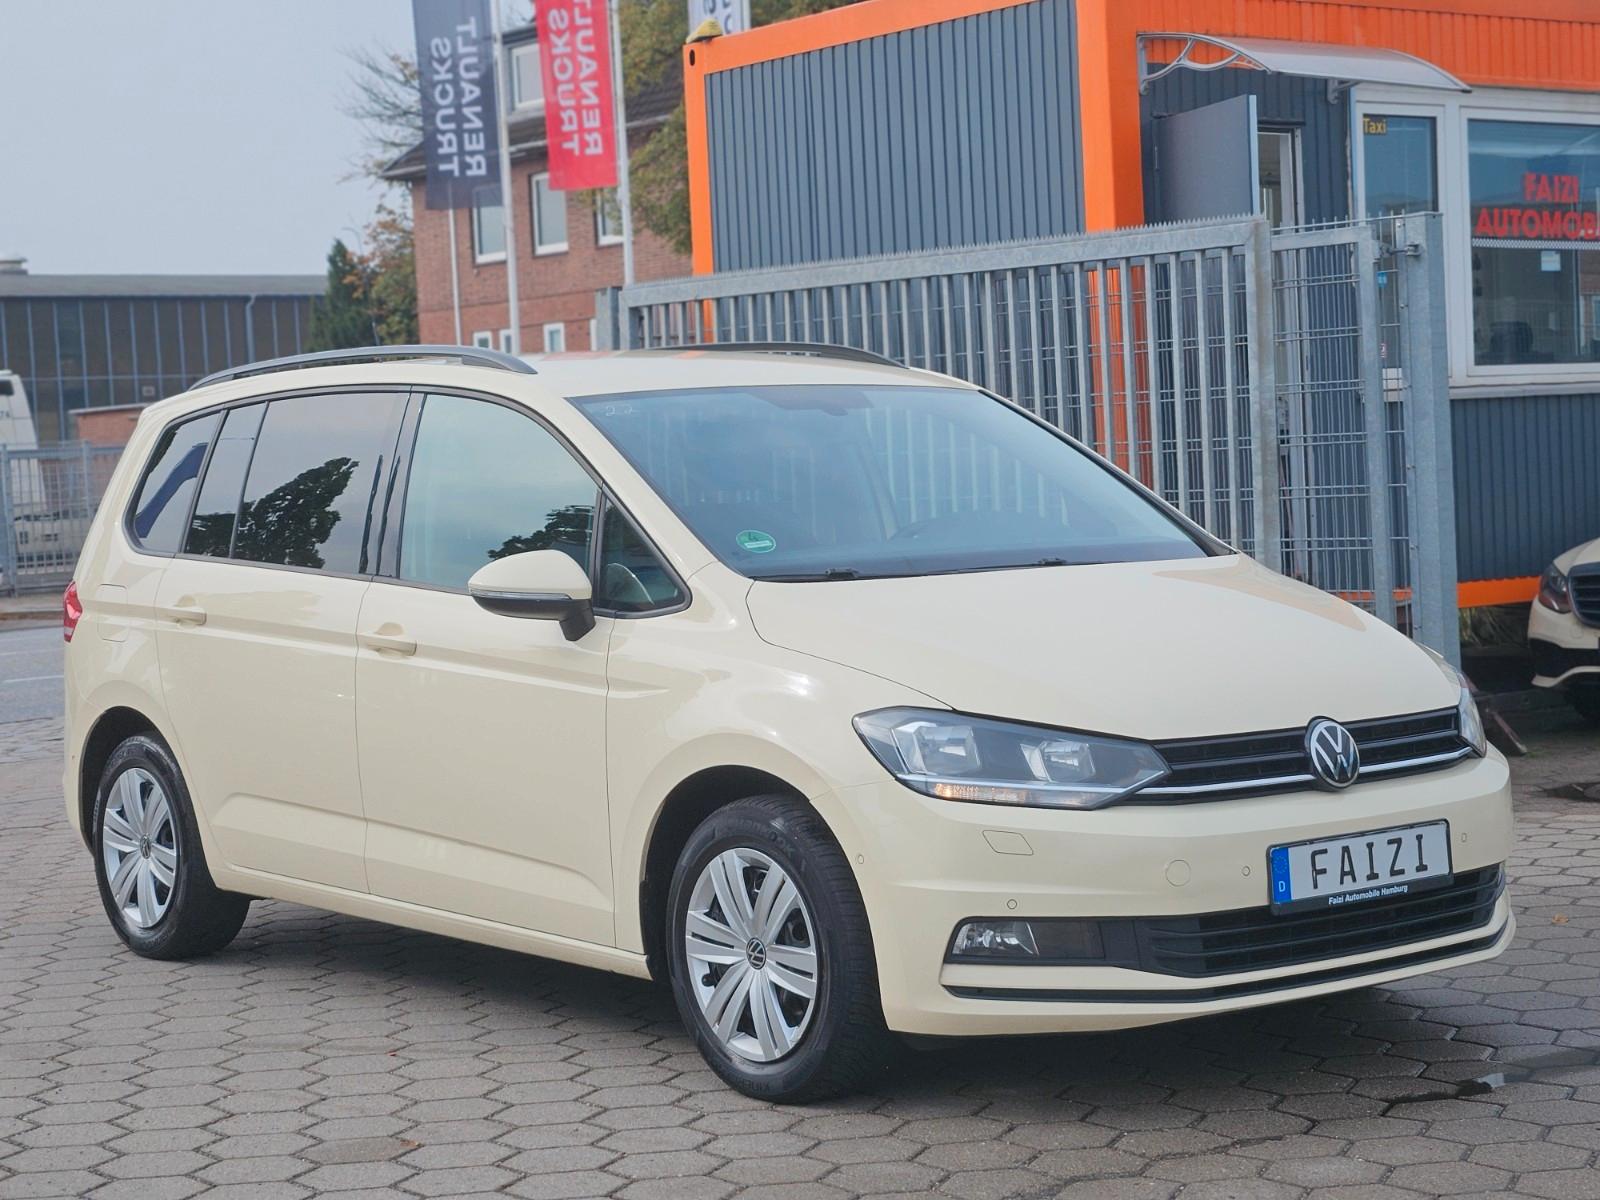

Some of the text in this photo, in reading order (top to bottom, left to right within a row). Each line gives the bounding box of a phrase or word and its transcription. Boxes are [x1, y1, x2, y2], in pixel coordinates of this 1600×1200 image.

[1363, 117, 1387, 134] Taxi
[1524, 172, 1579, 204] FAIZI
[1310, 834, 1428, 890] FAIZI
[1278, 880, 1286, 893] D
[1328, 885, 1409, 905] Faizi Automobile Hamburg
